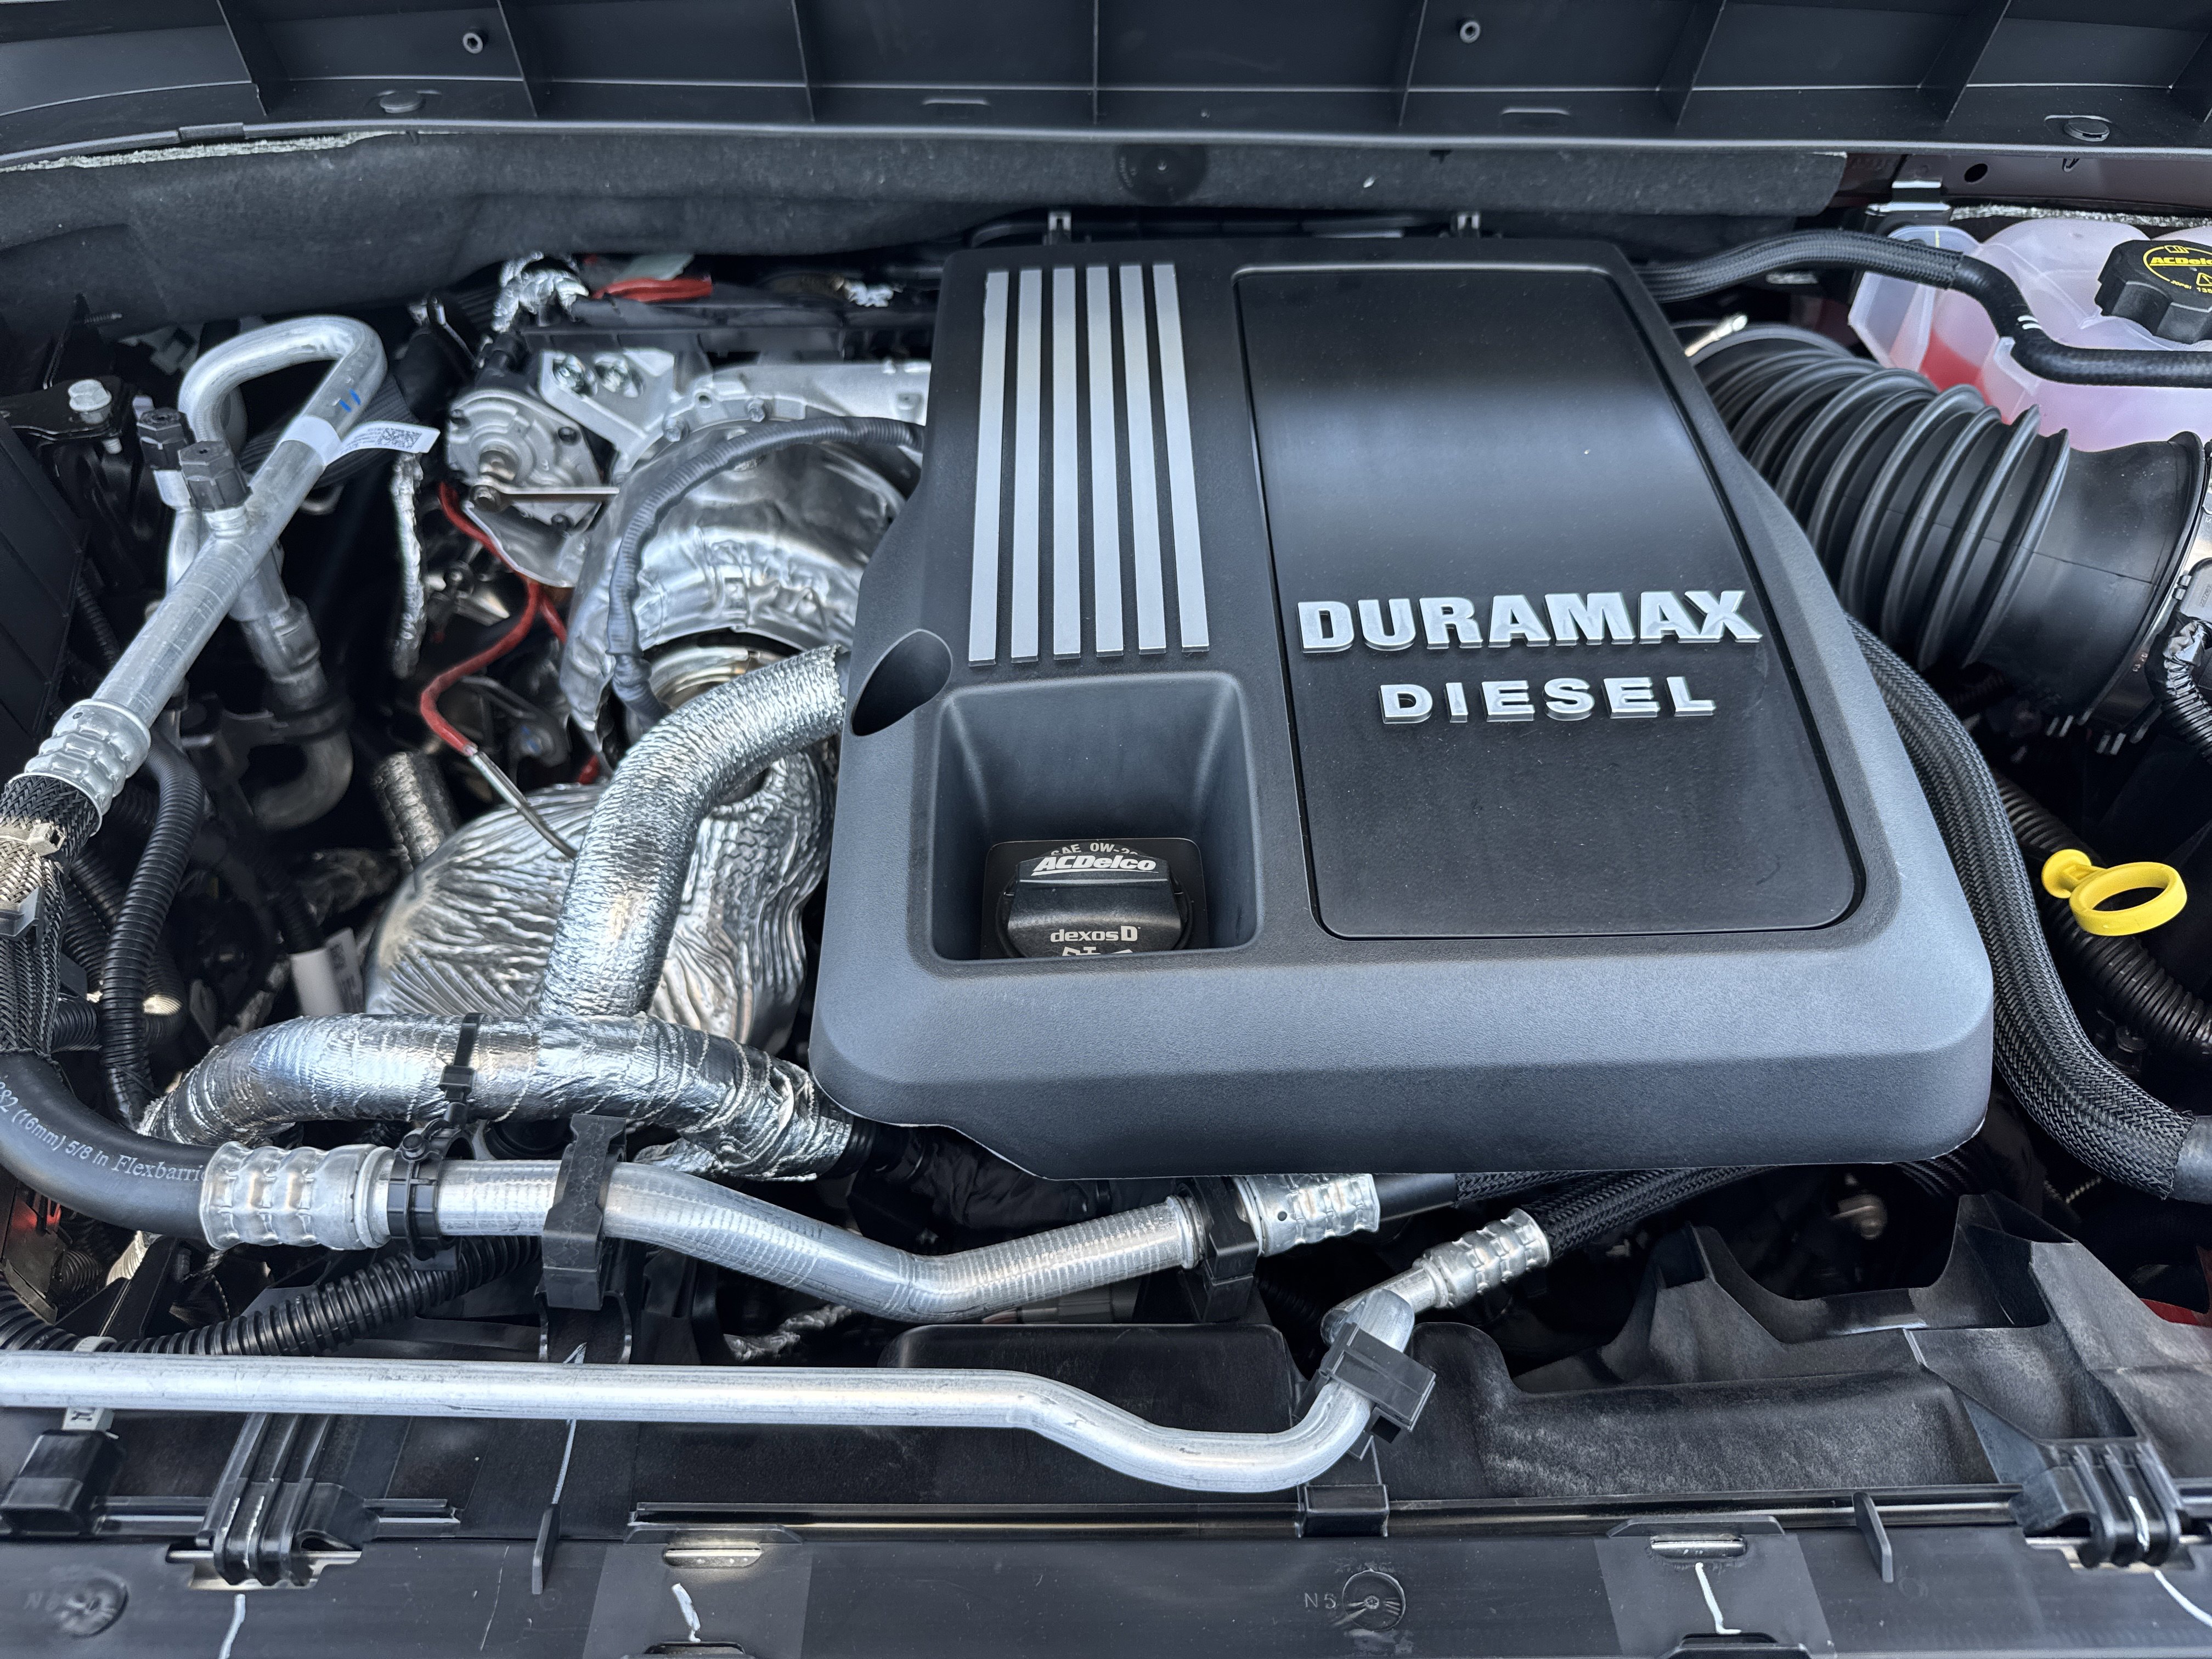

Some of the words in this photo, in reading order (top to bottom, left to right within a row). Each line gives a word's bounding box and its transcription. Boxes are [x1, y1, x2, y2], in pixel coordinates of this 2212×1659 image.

[1297, 590, 1762, 653] DURAMAX
[1378, 676, 1716, 724] DIESEL
[1032, 855, 1156, 872] ACDelco
[1090, 843, 1138, 855] 0W-2
[11, 1109, 67, 1151] (16mm)
[65, 1140, 93, 1160] 5/8
[92, 1150, 109, 1166] in
